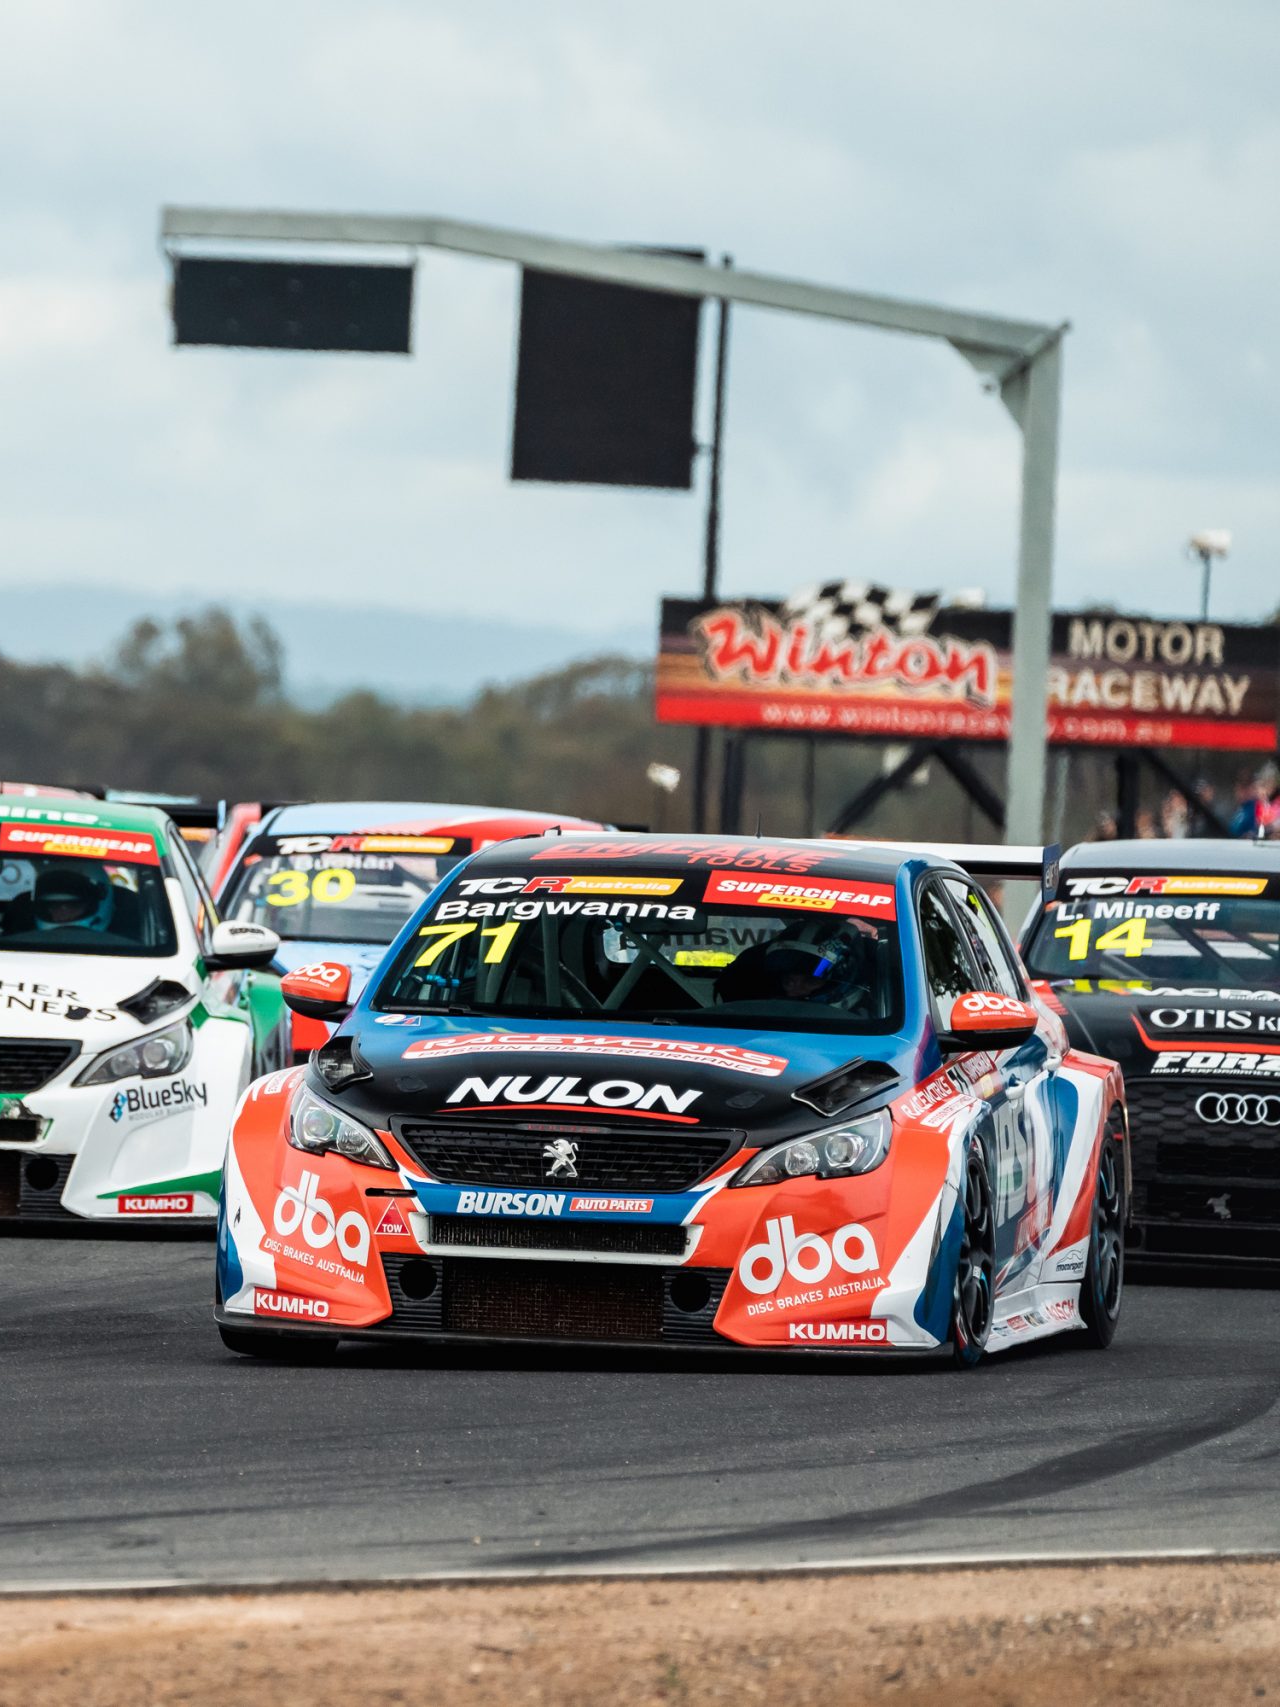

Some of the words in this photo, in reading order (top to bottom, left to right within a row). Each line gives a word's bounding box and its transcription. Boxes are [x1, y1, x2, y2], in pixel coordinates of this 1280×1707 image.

[699, 611, 991, 698] Winton
[1069, 617, 1225, 667] MOTOR
[1047, 666, 1251, 715] RACEWAY
[8, 830, 152, 853] SUPERCHEAP
[276, 836, 368, 854] TCR
[687, 853, 818, 873] TOOLS
[266, 868, 356, 907] 30
[458, 876, 573, 896] TCR
[572, 880, 672, 893] Australia
[716, 880, 892, 906] SUPERCHEAP
[1066, 876, 1169, 896] TCR
[1169, 880, 1258, 891] Australia
[434, 900, 697, 921] Bargwanna
[767, 895, 827, 906] AUTO
[1056, 903, 1084, 921] L.
[1094, 901, 1220, 921] Mineeff
[414, 922, 520, 968] 71
[1054, 918, 1153, 961] 14
[962, 993, 1025, 1012] dba
[1150, 1008, 1252, 1030] OTIS
[418, 1045, 521, 1058] PASSION
[529, 1045, 576, 1053] FOR
[585, 1046, 769, 1075] PERFORMANCE
[422, 1035, 775, 1066] RACEWORKS
[1181, 1067, 1271, 1077] PERFORMANCE
[126, 1079, 208, 1112] BlueSky
[446, 1076, 703, 1114] NULON
[125, 1197, 188, 1211] KUMHO
[456, 1191, 566, 1216] BURSON
[575, 1199, 610, 1211] AUTO
[610, 1199, 648, 1212] PARTS
[273, 1169, 370, 1267] dba
[381, 1223, 403, 1234] TOW
[263, 1237, 282, 1253] DISC
[283, 1246, 315, 1266] BRAKES
[316, 1259, 366, 1285] AUSTRALIA
[739, 1215, 880, 1295] dba
[256, 1292, 329, 1317] KUMHO
[747, 1301, 775, 1316] DISC
[776, 1290, 824, 1310] BRAKES
[828, 1276, 886, 1298] AUSTRALIA
[789, 1323, 886, 1340] KUMHO
